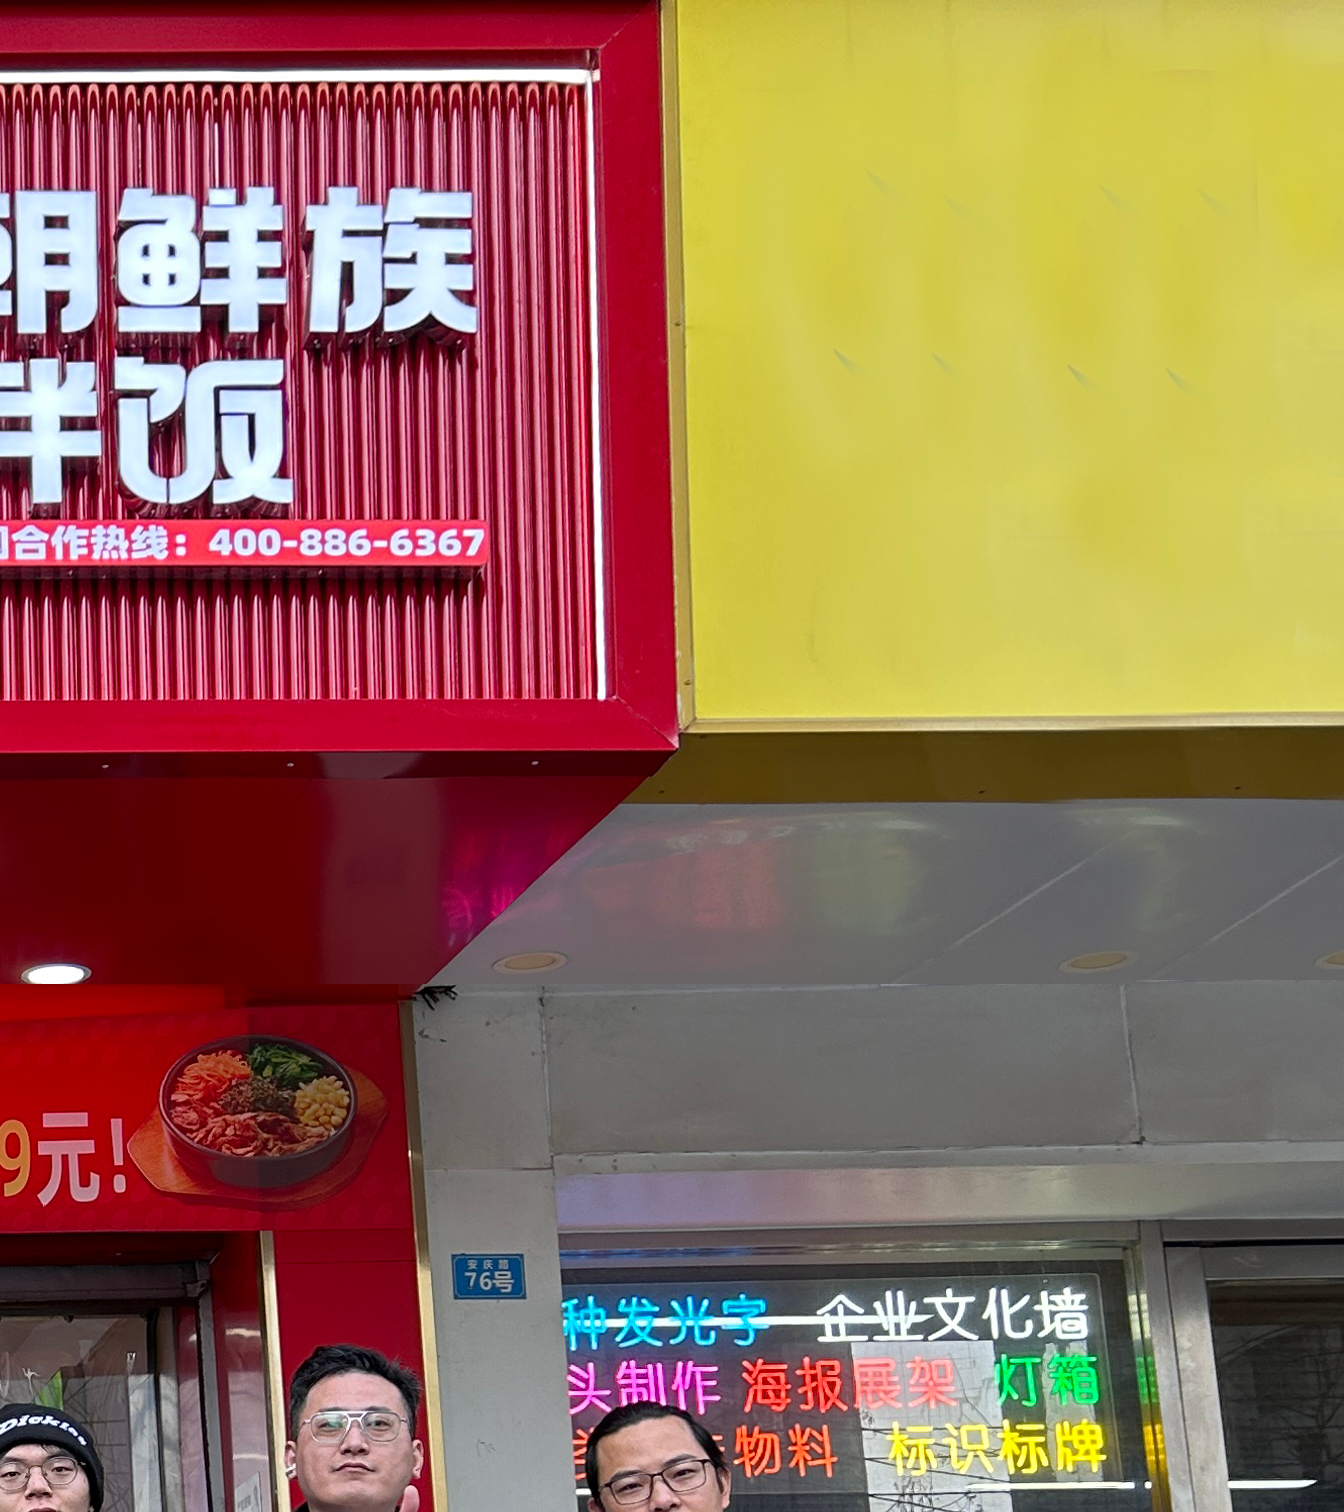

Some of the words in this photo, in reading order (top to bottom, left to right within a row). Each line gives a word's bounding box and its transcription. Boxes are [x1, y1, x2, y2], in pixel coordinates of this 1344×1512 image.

[464, 1271, 515, 1293] 76号
[816, 1287, 1089, 1341] 企业文化墙
[741, 1355, 958, 1414] 海报展架
[994, 1353, 1100, 1407] 灯箱
[885, 1418, 1107, 1477] 标识标牌
